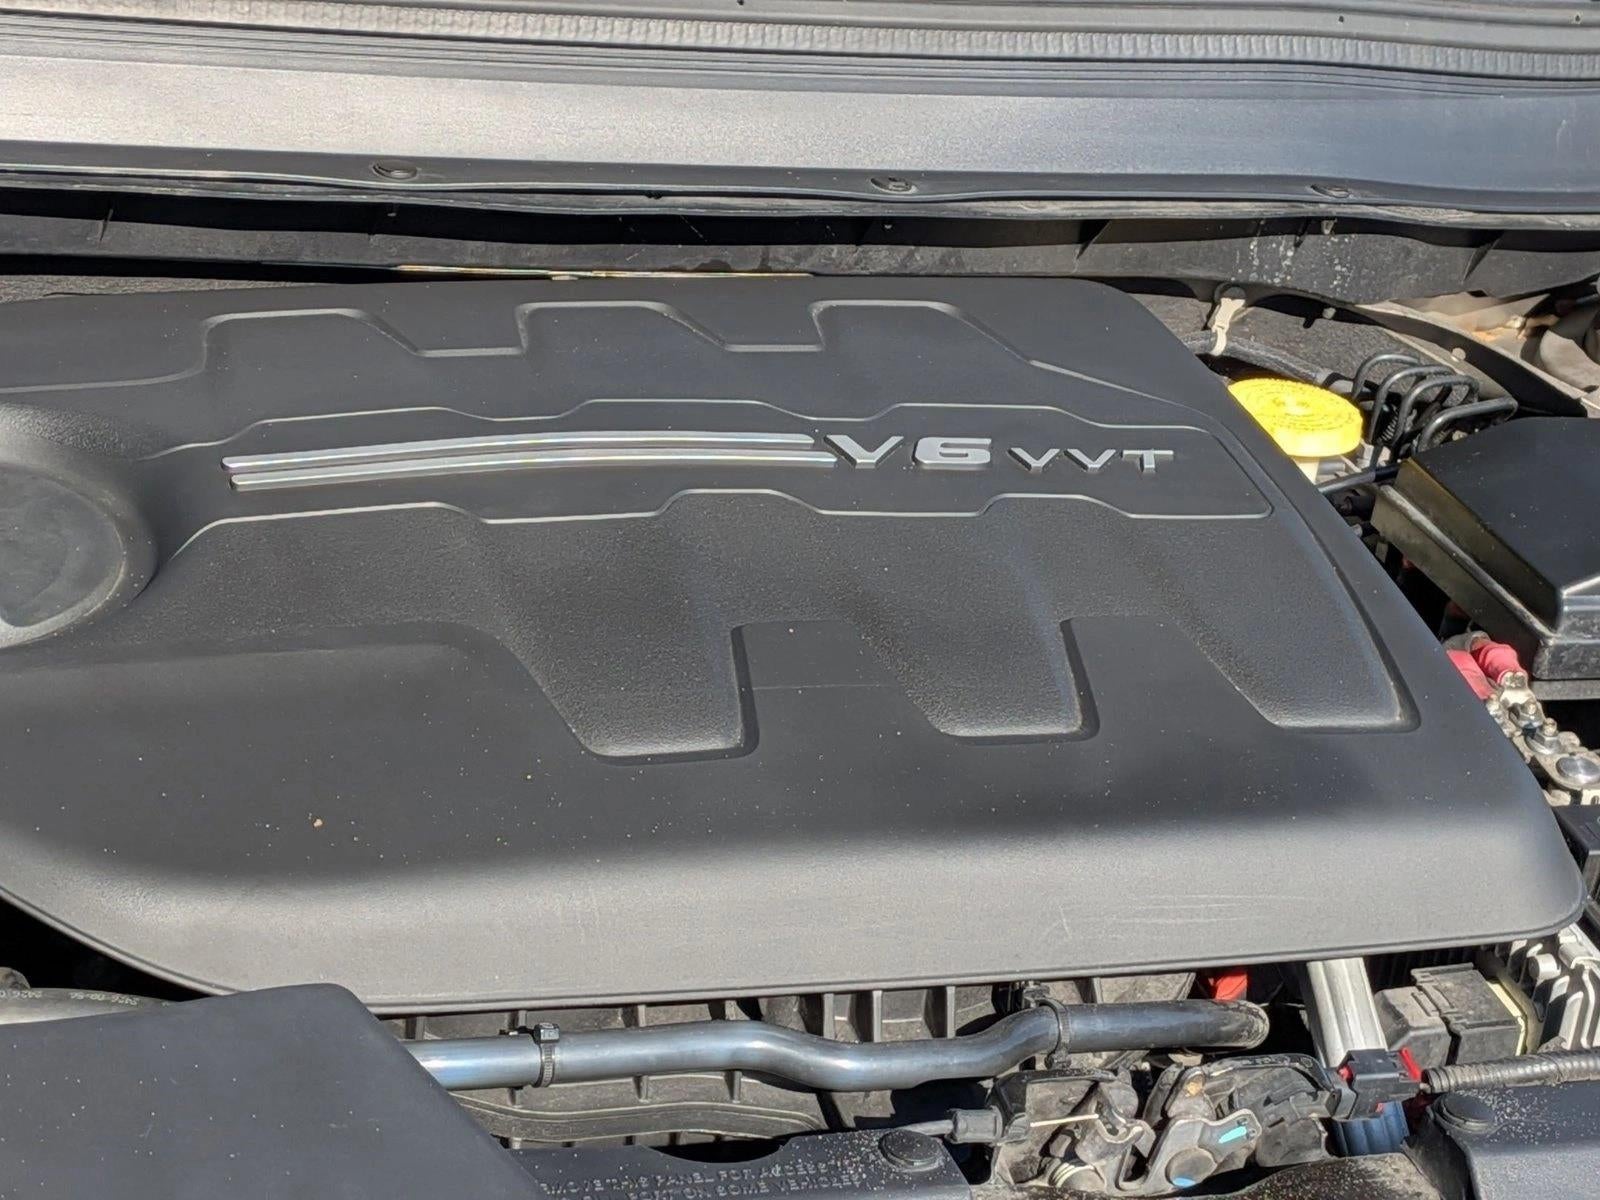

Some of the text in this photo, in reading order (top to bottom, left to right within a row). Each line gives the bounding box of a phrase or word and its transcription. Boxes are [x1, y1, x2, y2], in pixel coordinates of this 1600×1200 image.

[824, 434, 1174, 473] V6 VVT
[654, 1172, 715, 1187] PANEL
[716, 1180, 769, 1197] SOME
